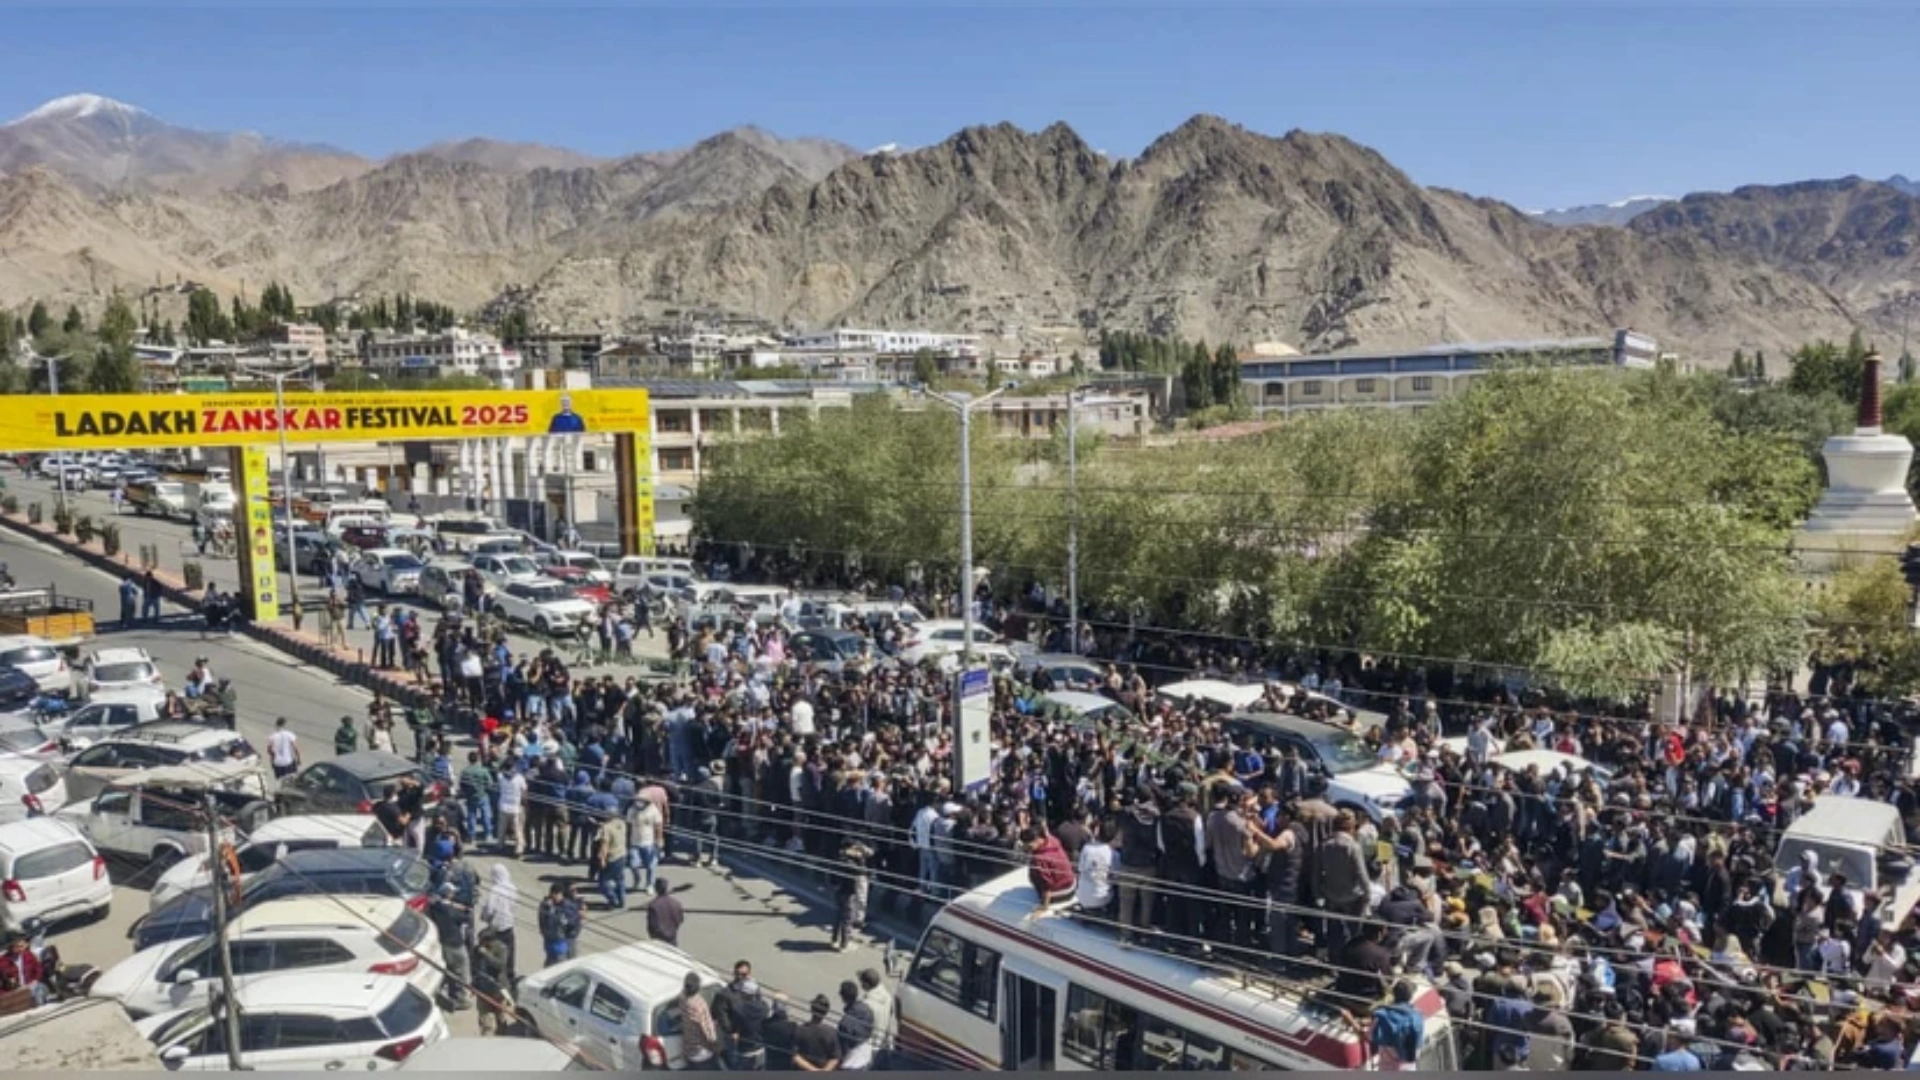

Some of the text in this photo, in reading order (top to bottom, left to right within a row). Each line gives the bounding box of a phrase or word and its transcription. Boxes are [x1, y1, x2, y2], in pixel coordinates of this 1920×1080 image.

[55, 404, 529, 437] LADAKH ZANSKAR FESTIVAL 2025
